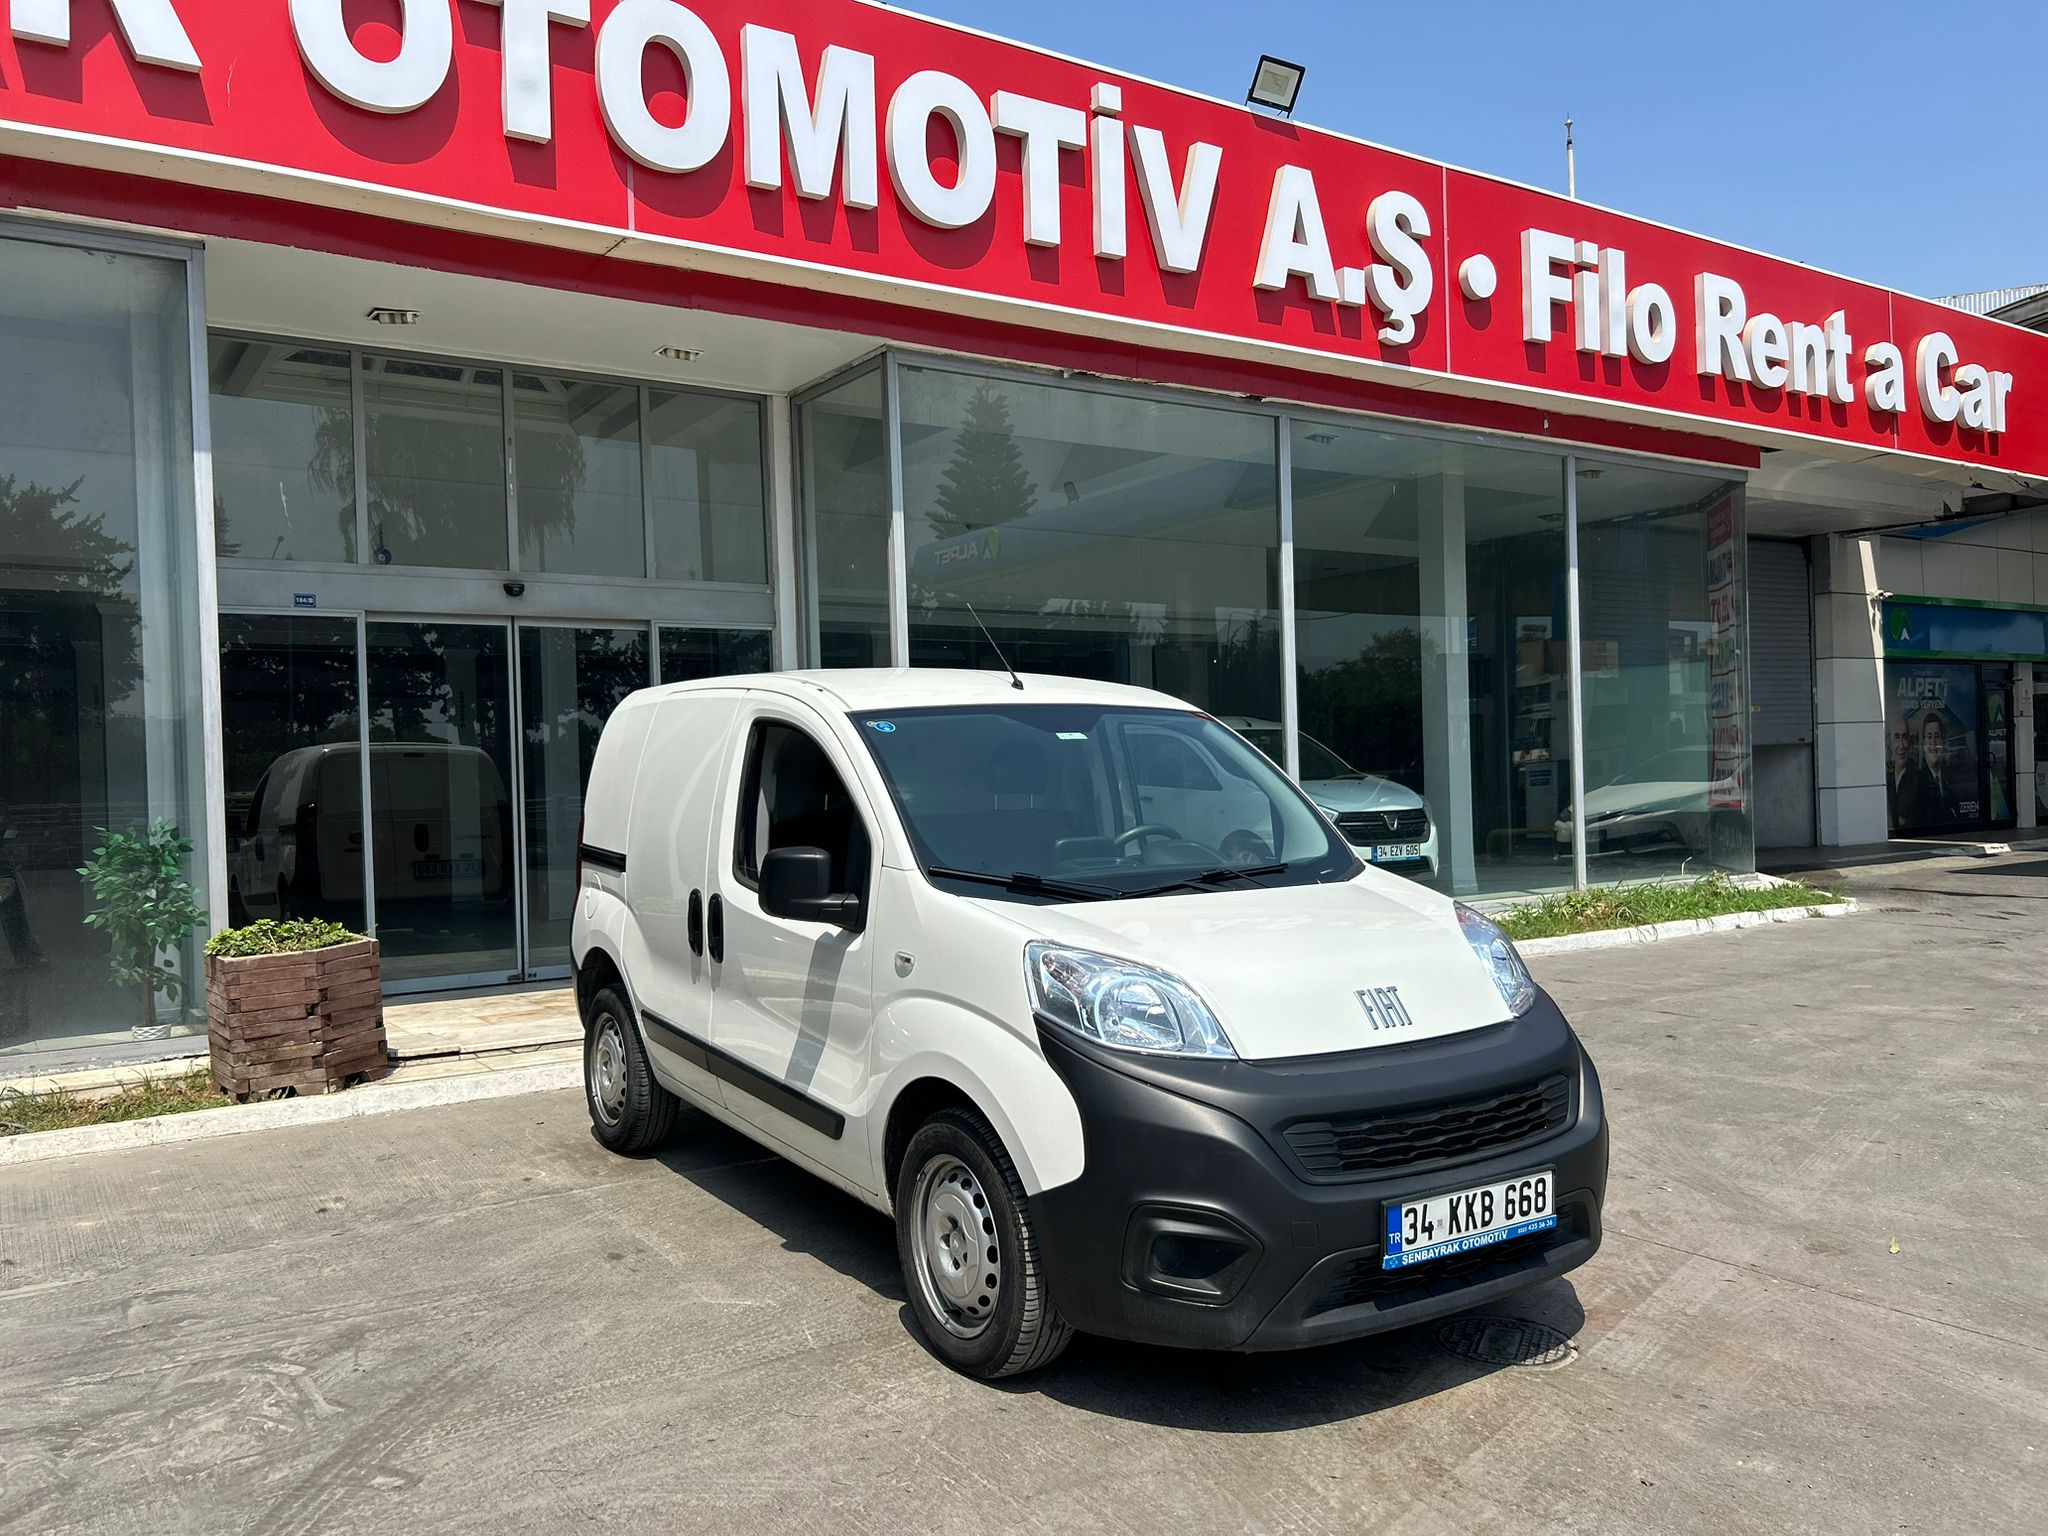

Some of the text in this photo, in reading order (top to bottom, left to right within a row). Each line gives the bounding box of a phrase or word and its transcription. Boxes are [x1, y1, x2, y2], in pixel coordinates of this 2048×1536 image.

[1520, 228, 1677, 365] Filo
[1695, 272, 1855, 404] Rent
[1864, 341, 1906, 414] a
[1916, 331, 2014, 434] Car
[1378, 846, 1388, 858] 34
[1353, 986, 1413, 1031] FIAT
[1389, 1177, 1547, 1246] TR 34 KKB 668
